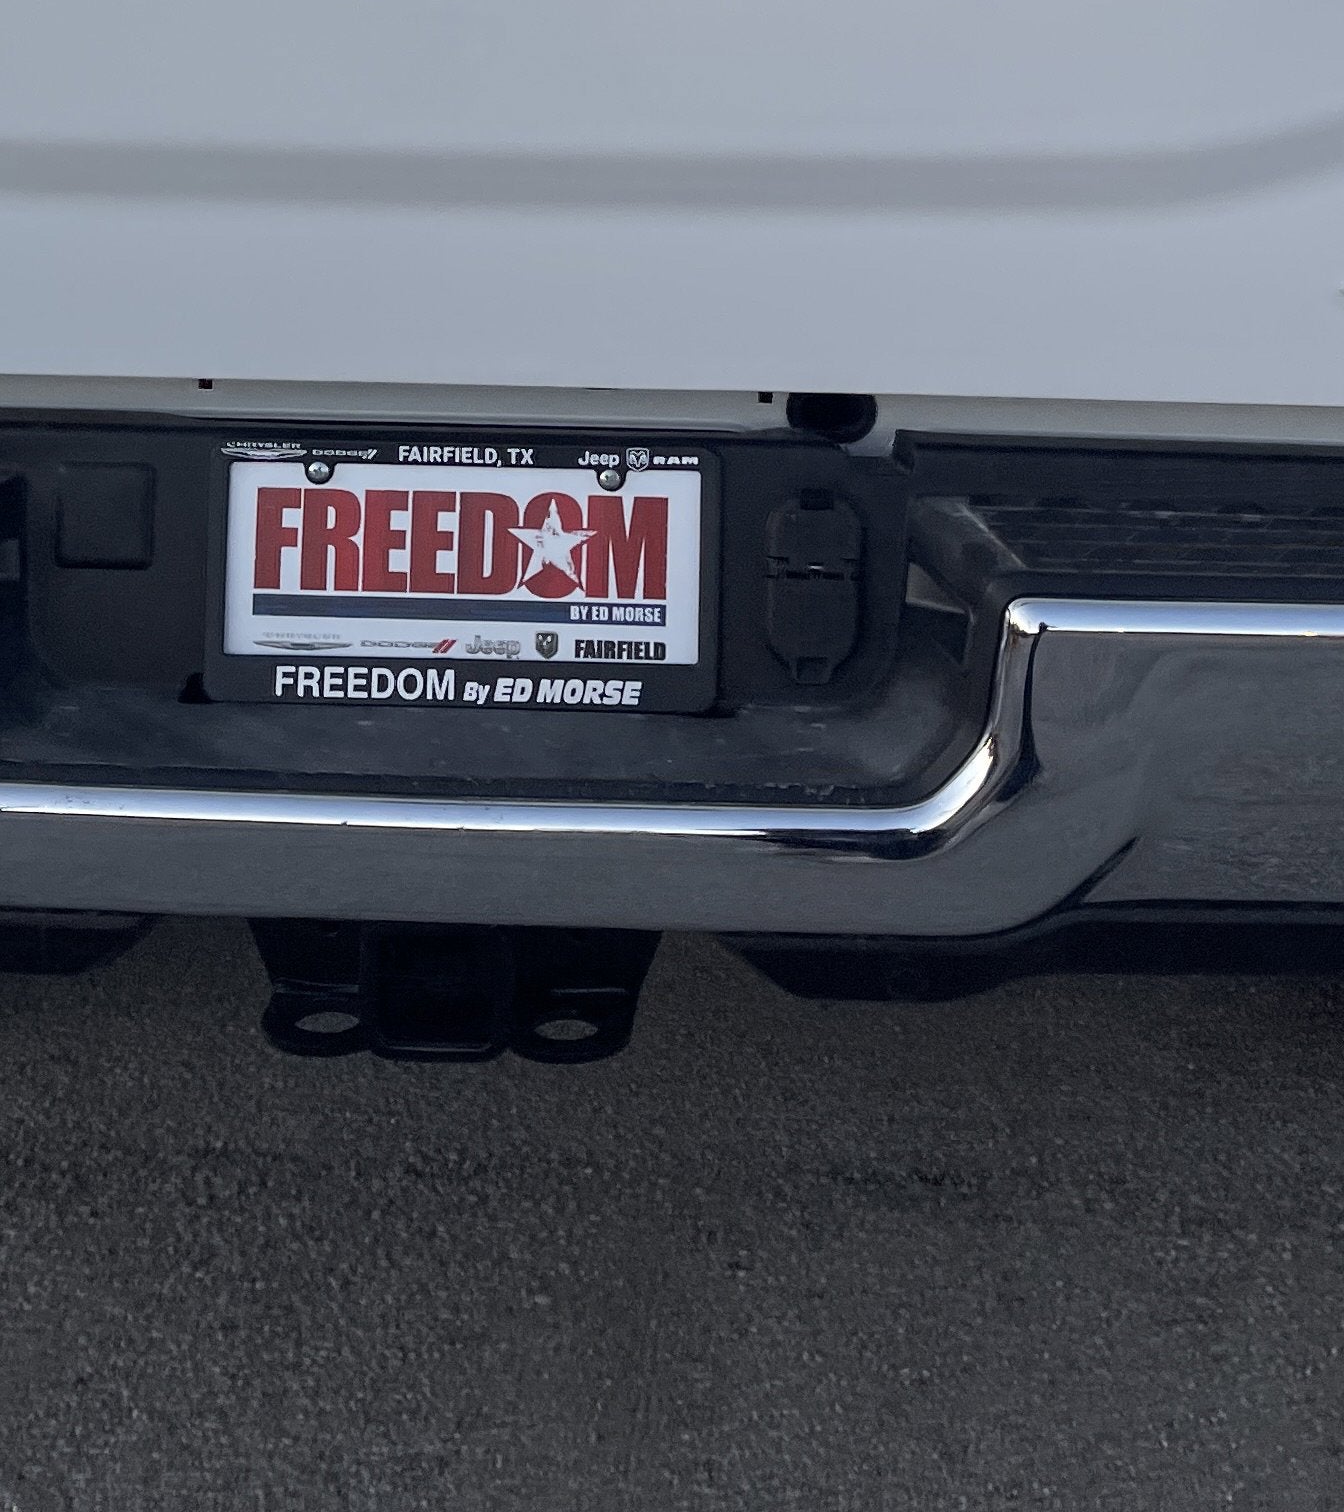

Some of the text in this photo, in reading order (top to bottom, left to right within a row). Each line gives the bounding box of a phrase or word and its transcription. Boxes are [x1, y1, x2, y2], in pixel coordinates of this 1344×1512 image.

[398, 445, 534, 468] FAIRFIELD, TX
[578, 450, 620, 468] Jeep
[653, 455, 700, 466] RAM
[254, 486, 669, 599] FREEDOM
[569, 604, 661, 623] BY ED MORSE
[464, 635, 522, 659] Jeep
[574, 639, 666, 661] FAIRFIELD
[275, 665, 642, 706] FREEDOM By ED MORSE
